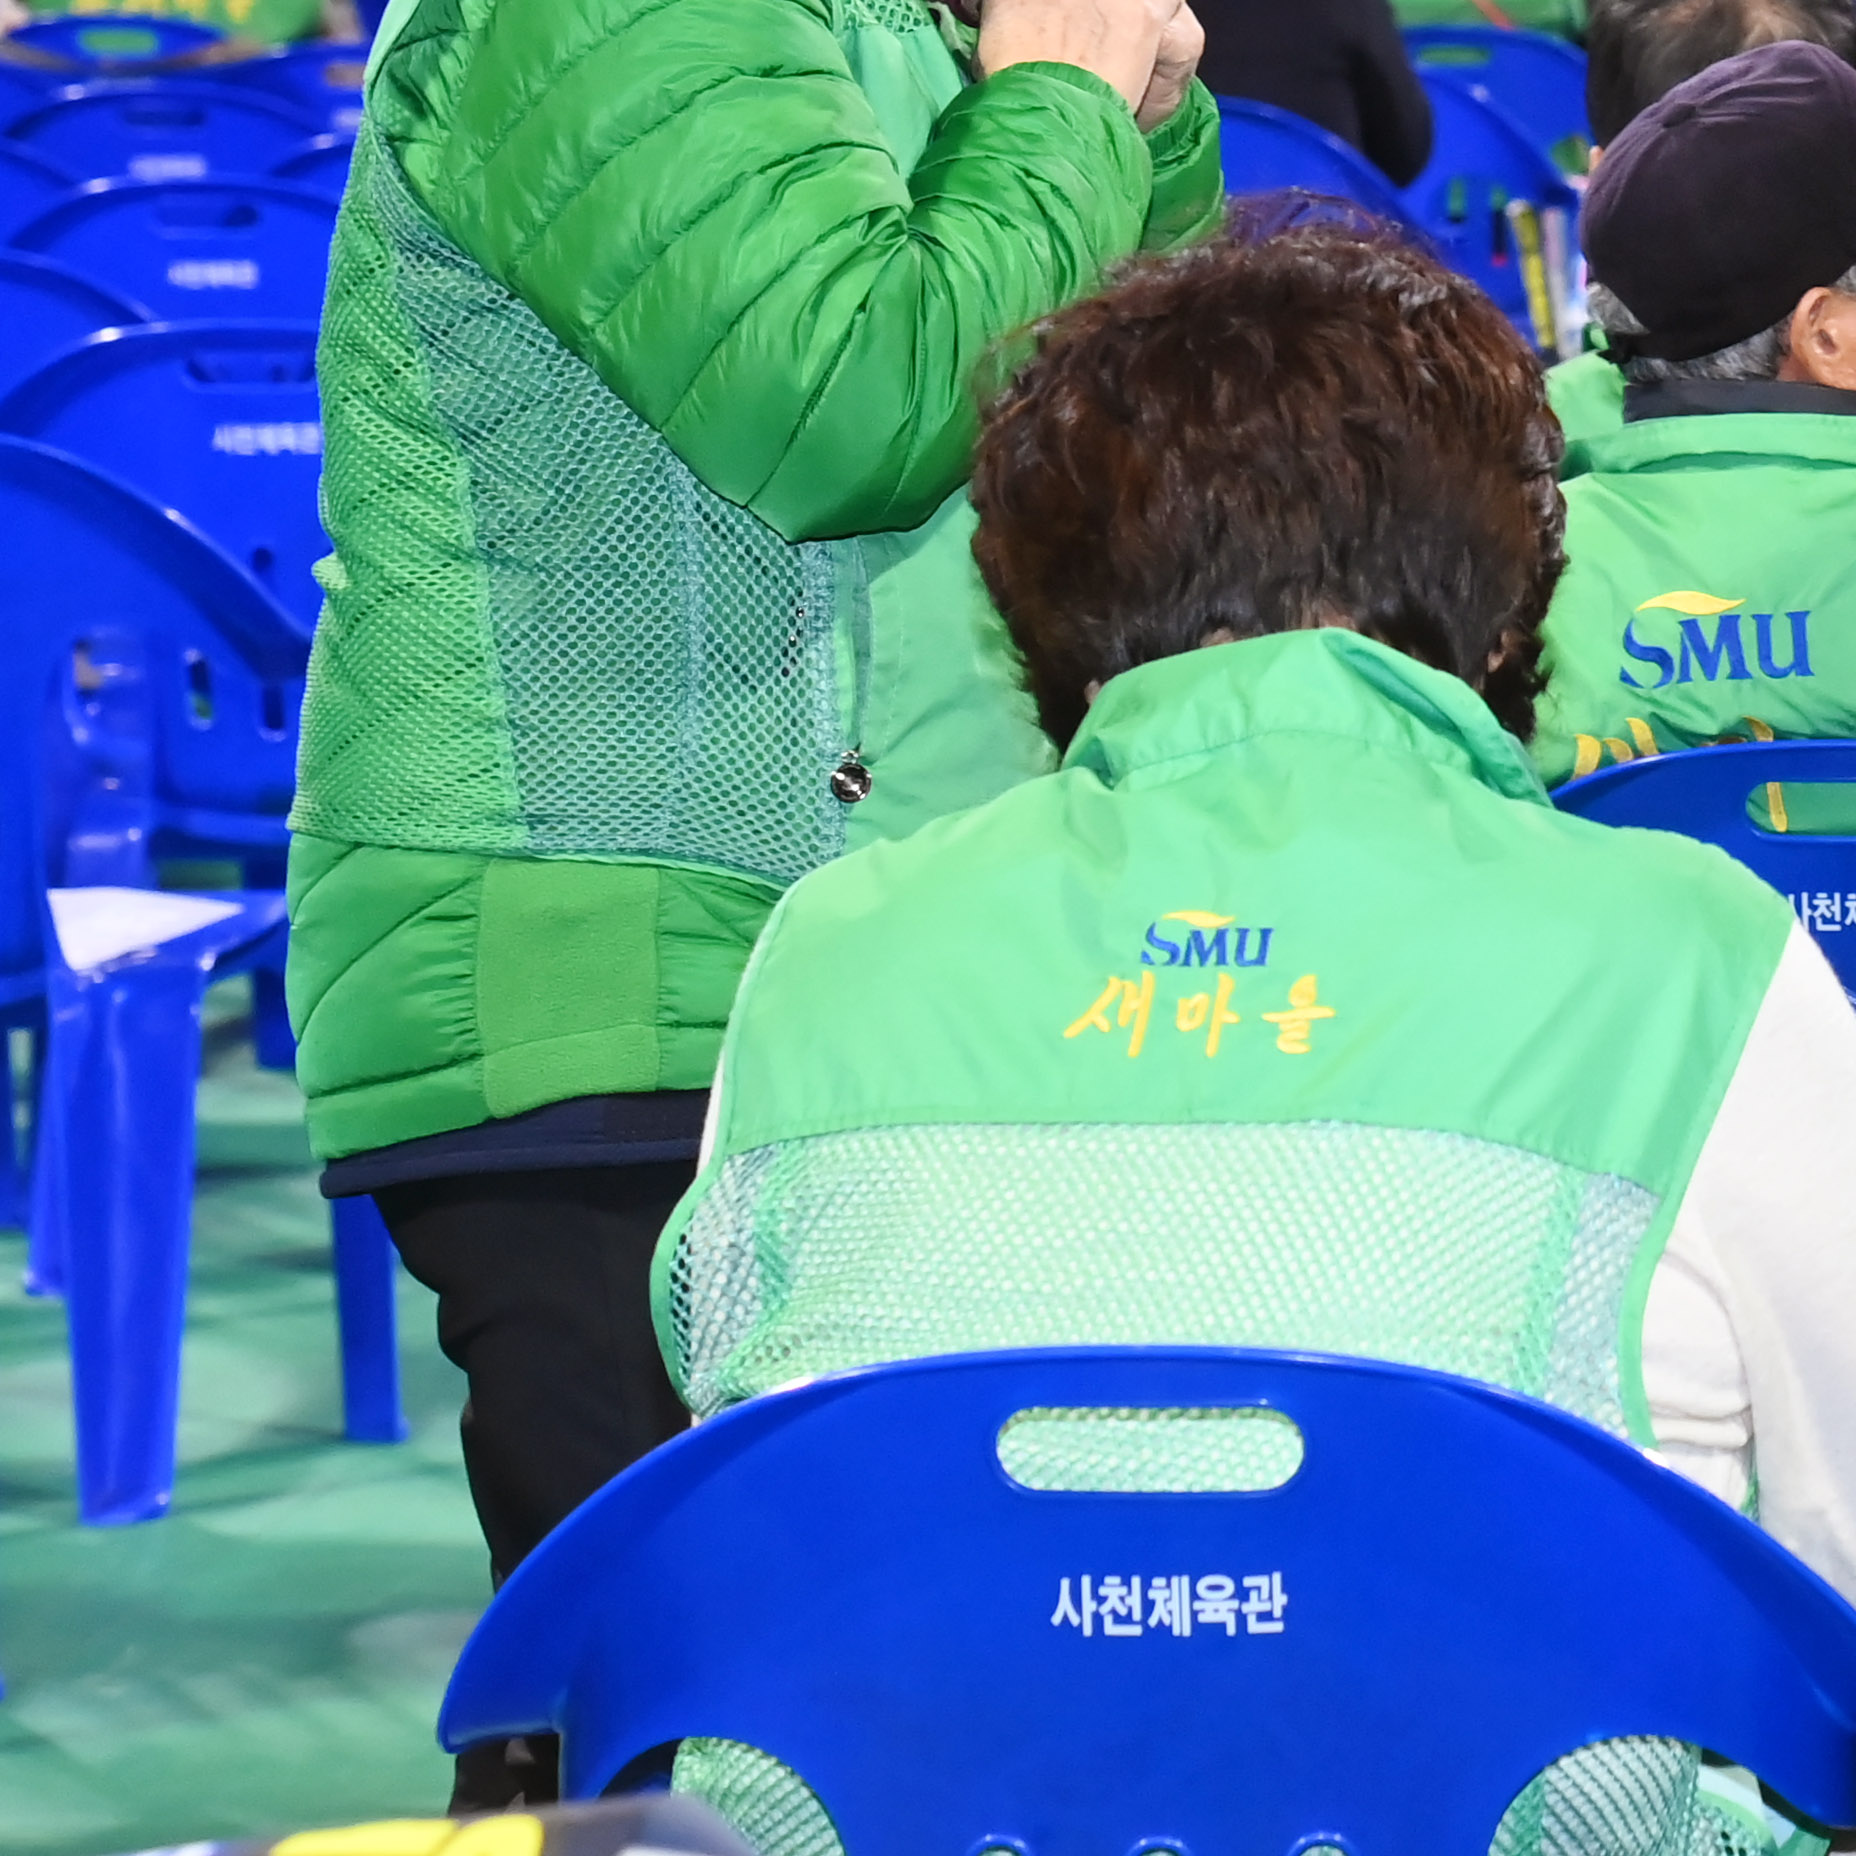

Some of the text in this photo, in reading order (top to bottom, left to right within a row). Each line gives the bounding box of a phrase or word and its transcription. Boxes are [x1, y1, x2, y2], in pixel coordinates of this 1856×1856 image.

[1619, 608, 1815, 690] SMU
[1140, 920, 1275, 968] SMU
[1063, 970, 1337, 1058] 새마을
[1050, 1570, 1289, 1638] 사천체육관
